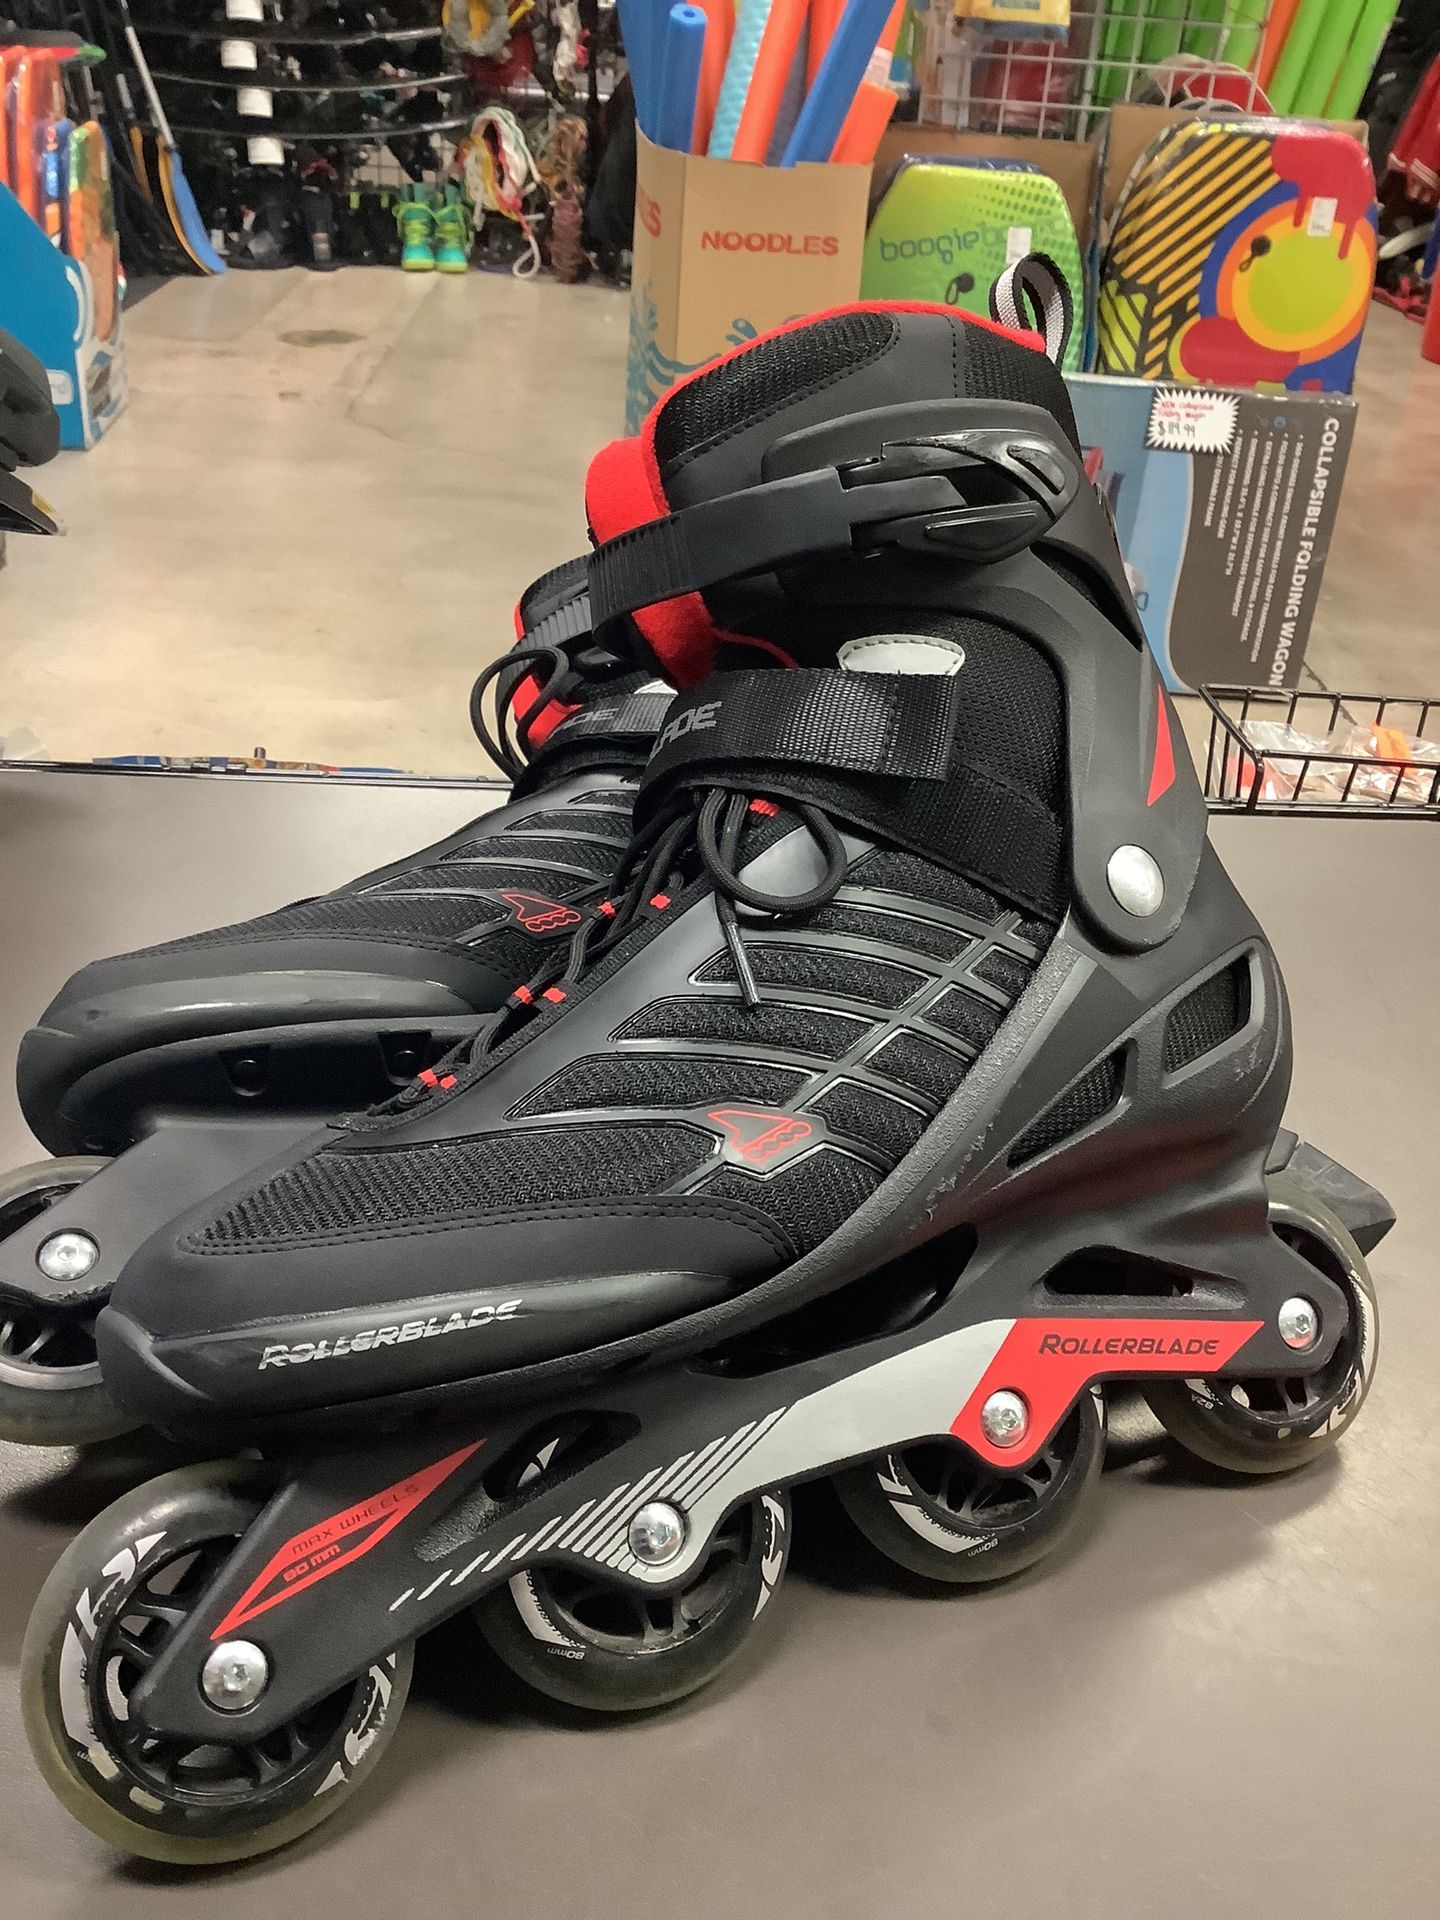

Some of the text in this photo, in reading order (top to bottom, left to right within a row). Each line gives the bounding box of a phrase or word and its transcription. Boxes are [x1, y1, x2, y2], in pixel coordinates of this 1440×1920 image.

[701, 230, 840, 256] NOODLES
[1268, 417, 1339, 686] COLLAPSIBLE FOLDING WAGON
[258, 1299, 523, 1370] ROLLERBLADE
[1038, 1334, 1220, 1356] ROLLERBLADE
[292, 1528, 333, 1555] MAX
[967, 1538, 999, 1557] 80mm
[546, 1647, 586, 1660] 80mm
